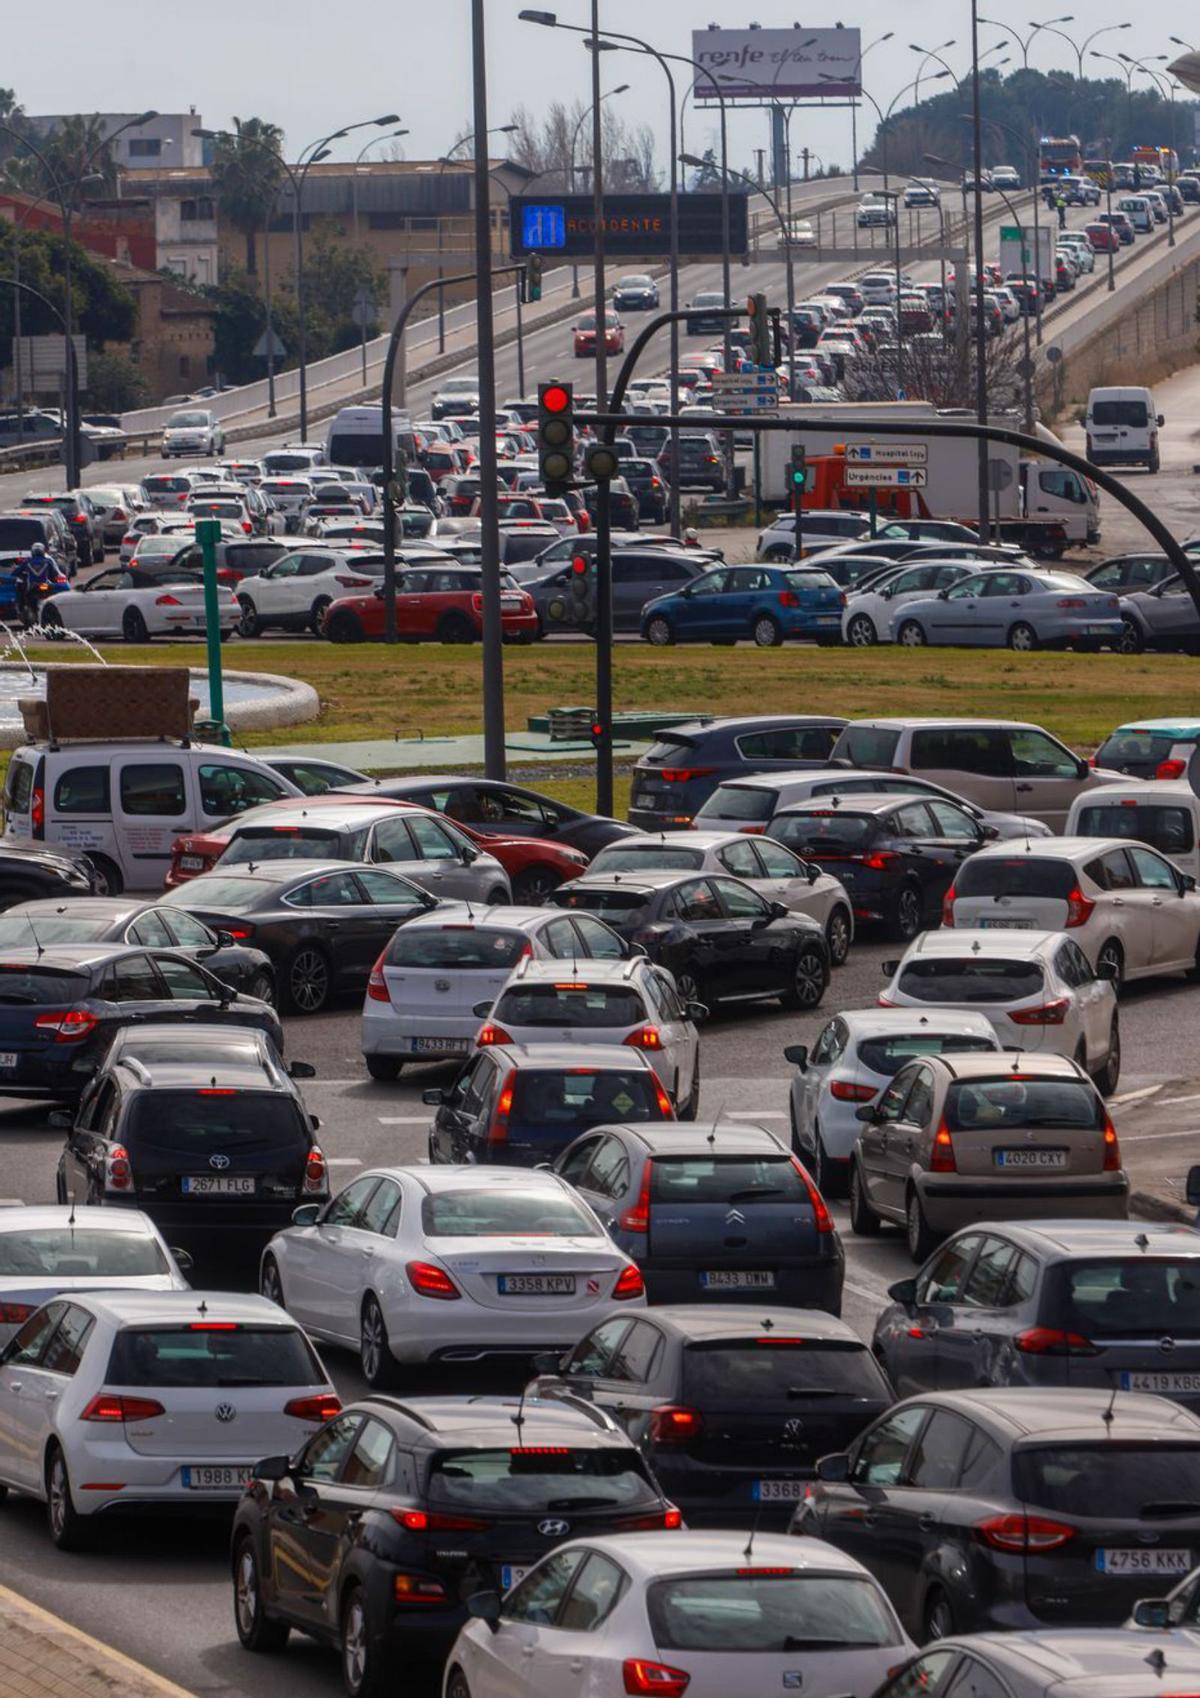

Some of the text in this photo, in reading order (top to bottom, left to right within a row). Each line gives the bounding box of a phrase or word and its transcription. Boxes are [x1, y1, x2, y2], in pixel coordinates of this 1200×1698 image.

[699, 43, 764, 69] renfe
[566, 216, 663, 233] ACCIDENTE
[875, 449, 908, 459] Hospital
[1006, 1152, 1036, 1164] 4020
[193, 1179, 250, 1191] 2671 FLG
[508, 1278, 572, 1290] 3358 KPV
[1133, 1376, 1169, 1390] 4419
[196, 1470, 233, 1484] 1988
[762, 1483, 800, 1498] 3368
[1109, 1552, 1187, 1568] 4756 KKK
